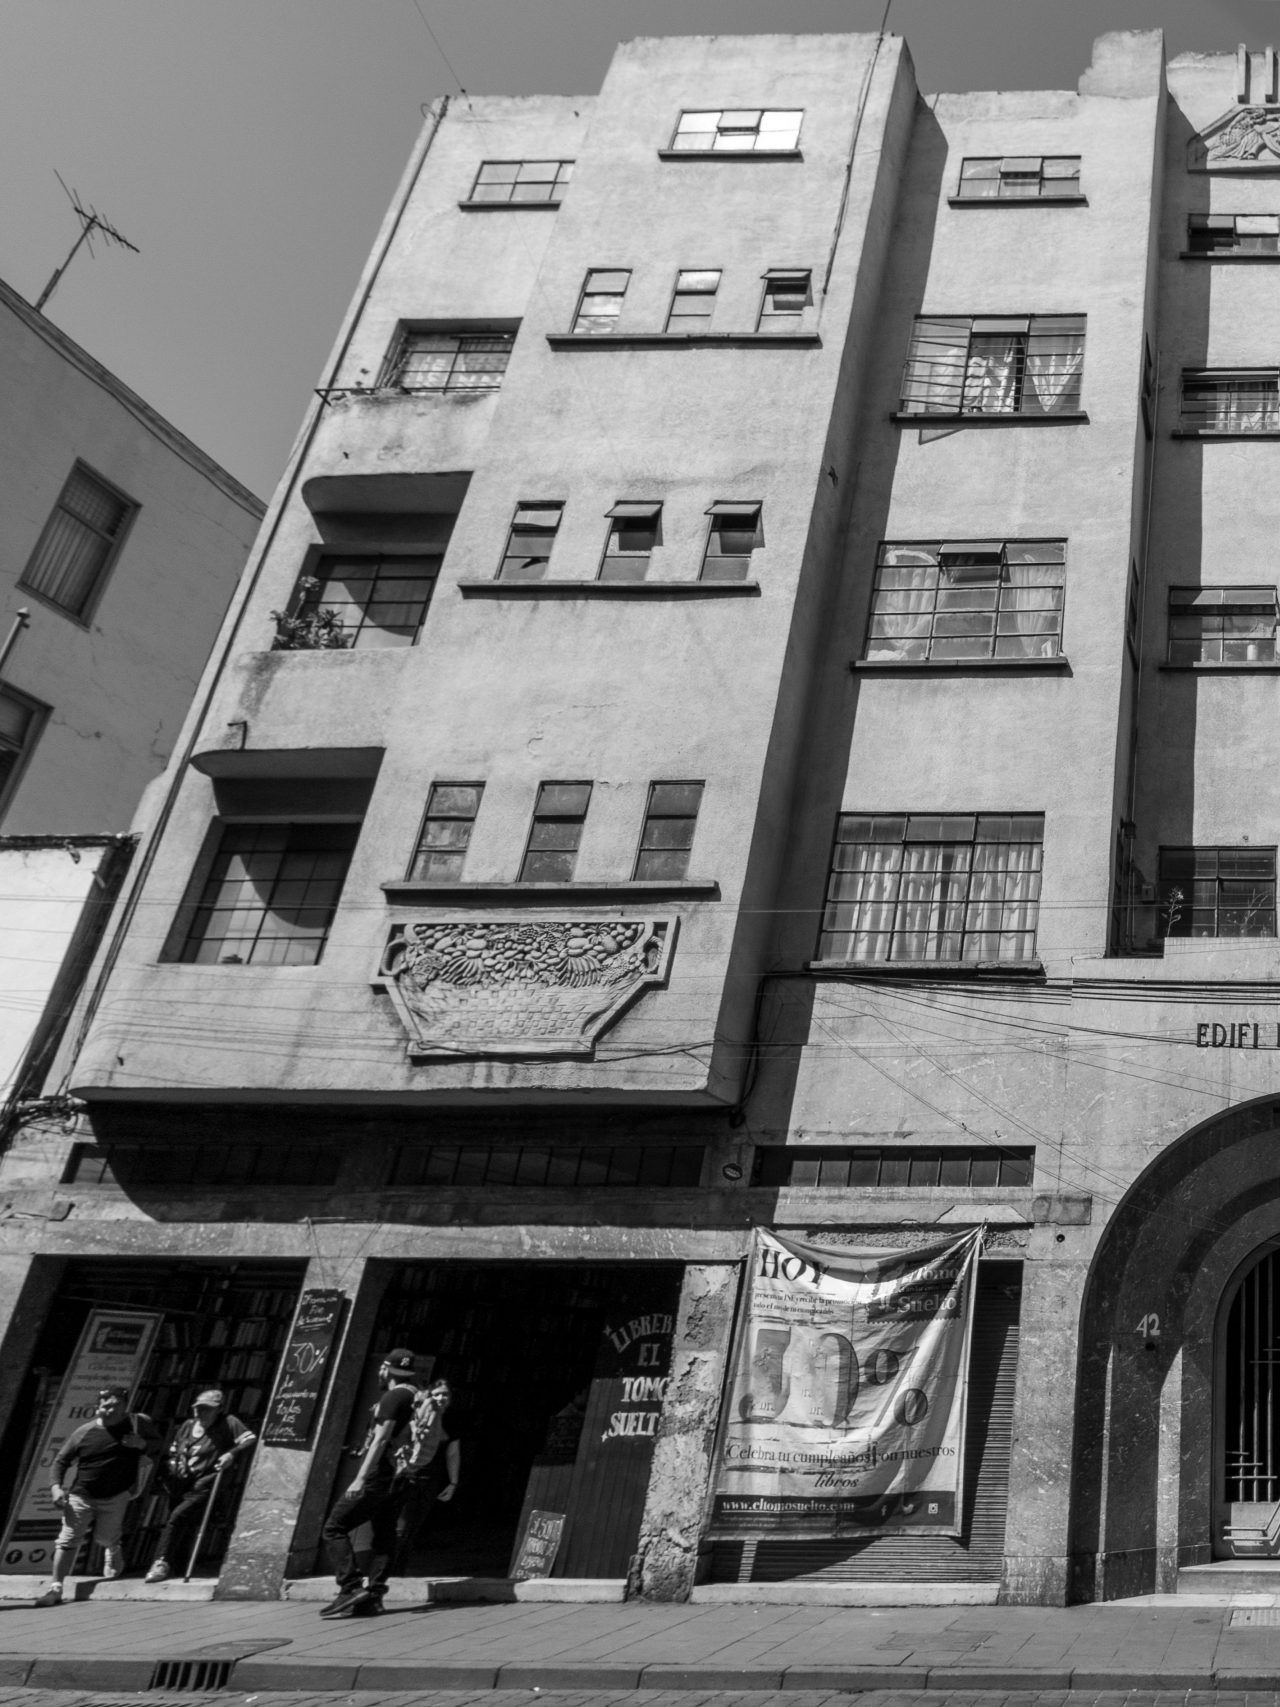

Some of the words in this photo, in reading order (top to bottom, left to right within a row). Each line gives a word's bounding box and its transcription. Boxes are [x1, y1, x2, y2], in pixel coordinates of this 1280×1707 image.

[758, 1248, 830, 1289] HOY
[897, 1293, 958, 1313] Suelto
[1133, 1312, 1161, 1338] 42
[286, 1342, 329, 1374] 30%
[637, 1343, 661, 1368] EL
[727, 1443, 775, 1462] Celebra
[777, 1449, 790, 1462] tu
[792, 1449, 871, 1469] cumpleaños
[902, 1447, 956, 1462] nuestros
[814, 1472, 859, 1489] libros
